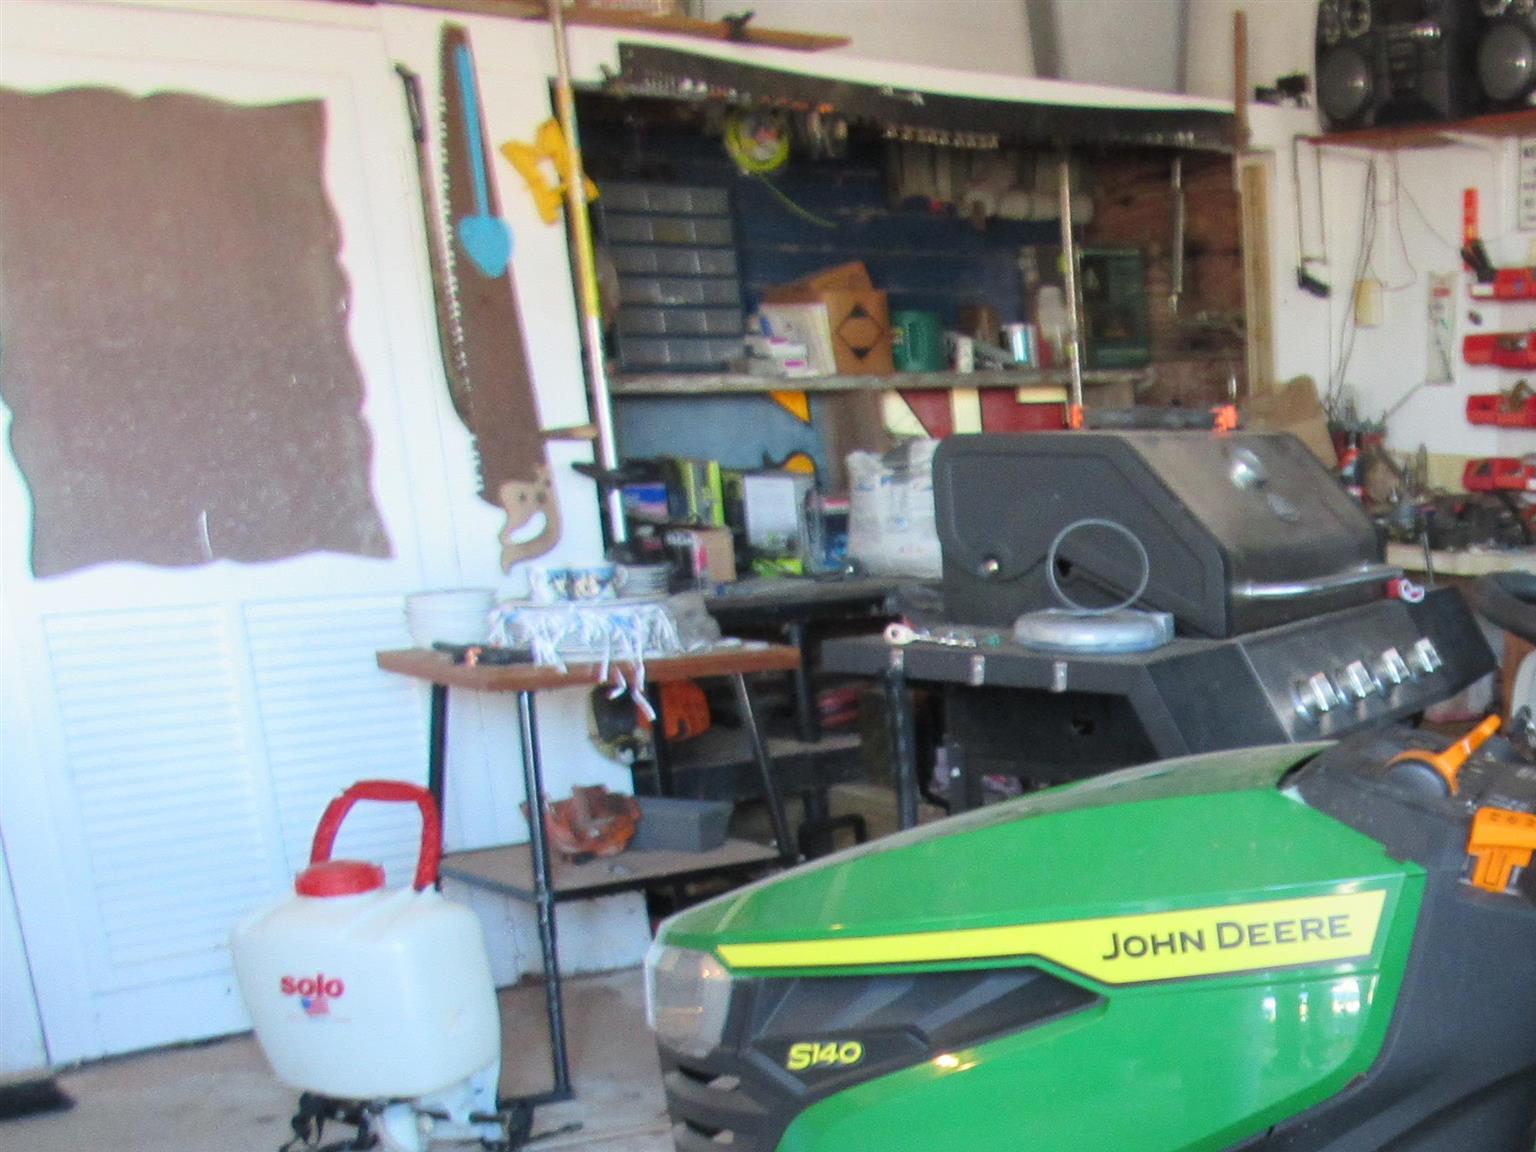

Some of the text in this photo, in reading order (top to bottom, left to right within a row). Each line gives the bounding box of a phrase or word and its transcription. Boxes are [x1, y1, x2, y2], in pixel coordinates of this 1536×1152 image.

[1102, 914, 1352, 961] JOHN DEERE
[280, 973, 345, 997] solo
[787, 1041, 862, 1071] S140
